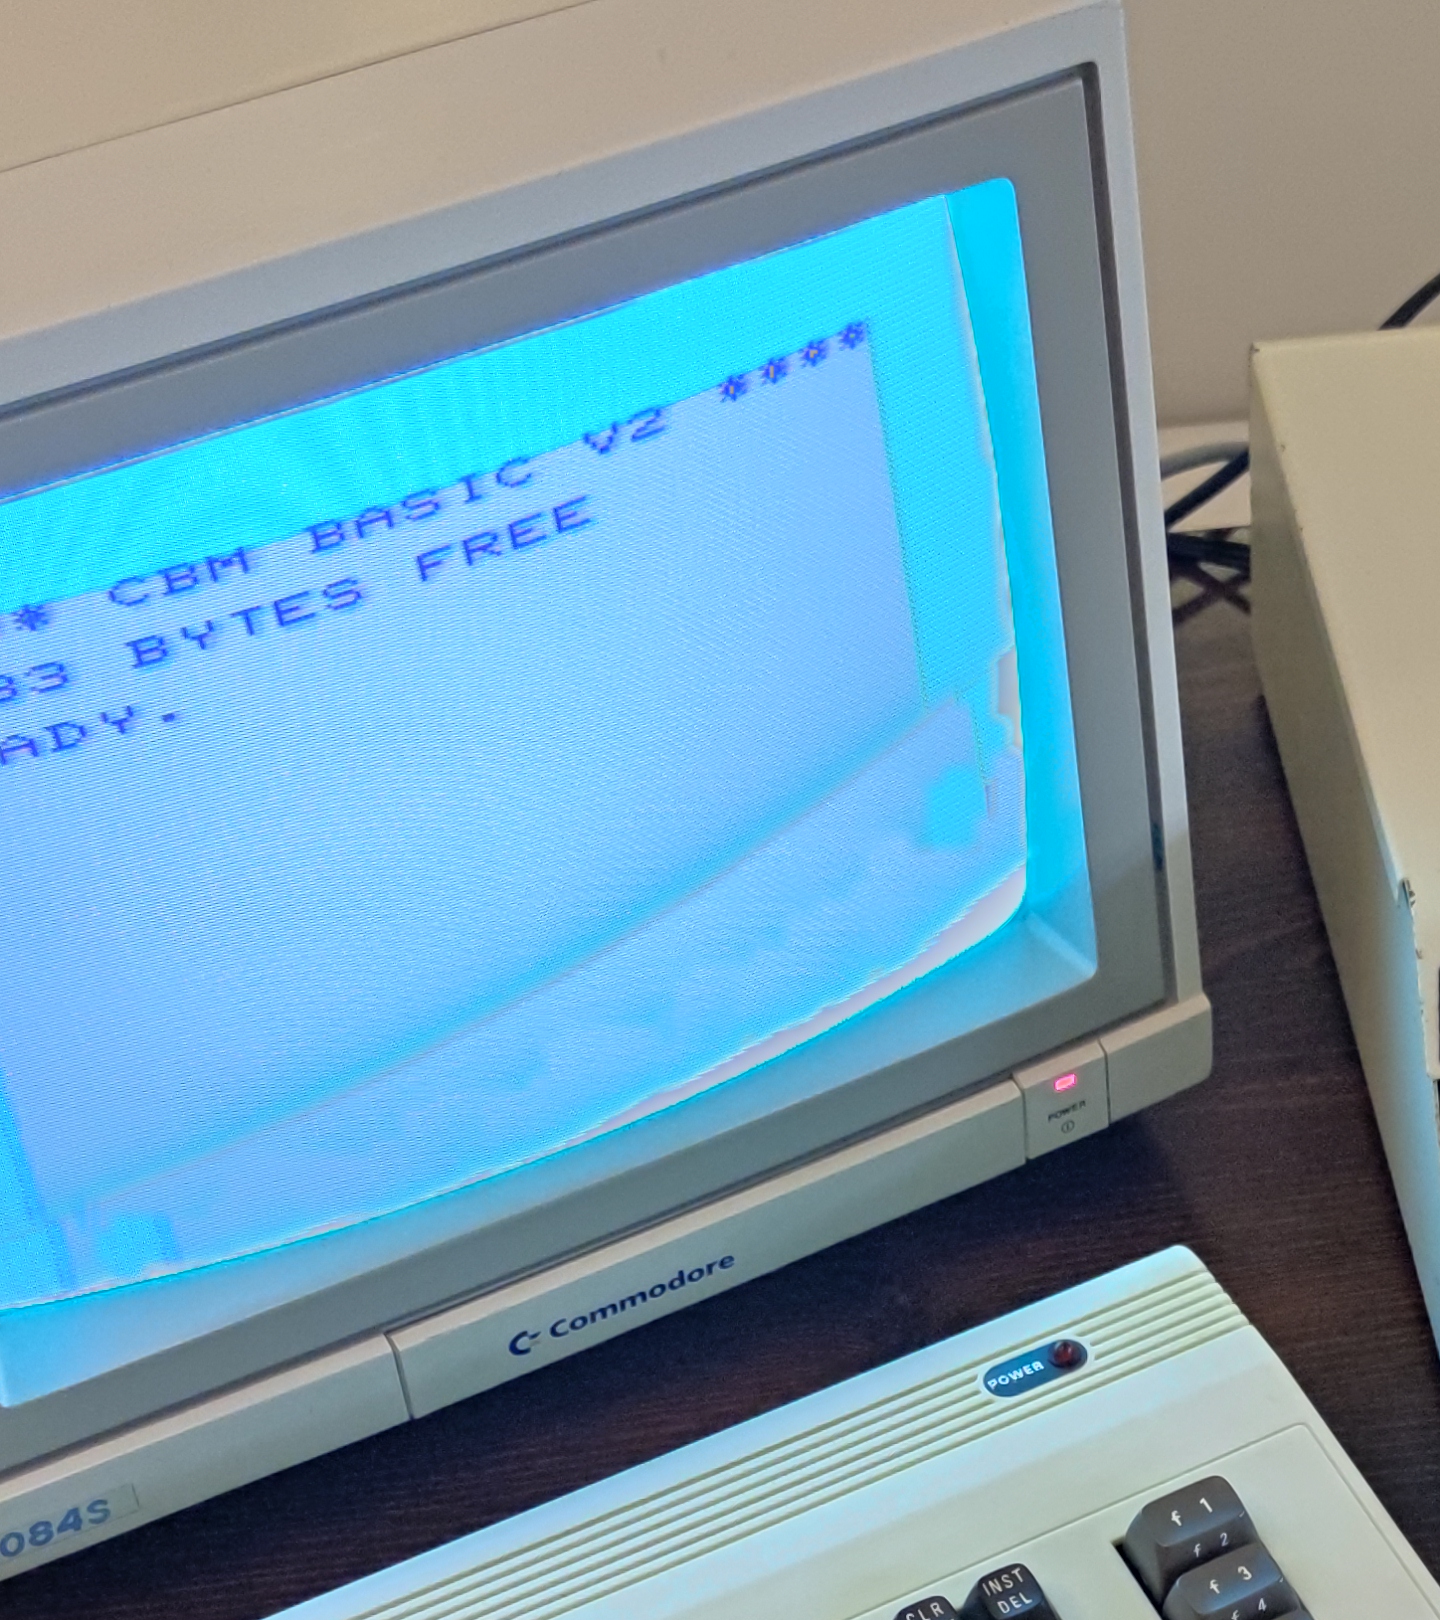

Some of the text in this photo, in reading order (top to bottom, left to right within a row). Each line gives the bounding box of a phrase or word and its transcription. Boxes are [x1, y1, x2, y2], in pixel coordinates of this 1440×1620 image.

[107, 545, 256, 605] CBM
[306, 455, 536, 557] BASIC
[581, 406, 668, 456] V2
[128, 577, 363, 670] BYTES
[415, 495, 595, 583] FREE
[1047, 1100, 1086, 1122] POWER
[549, 1254, 735, 1338] Commodore
[987, 1360, 1044, 1391] POWER
[980, 1568, 1025, 1598] INST
[996, 1592, 1033, 1615] DEL
